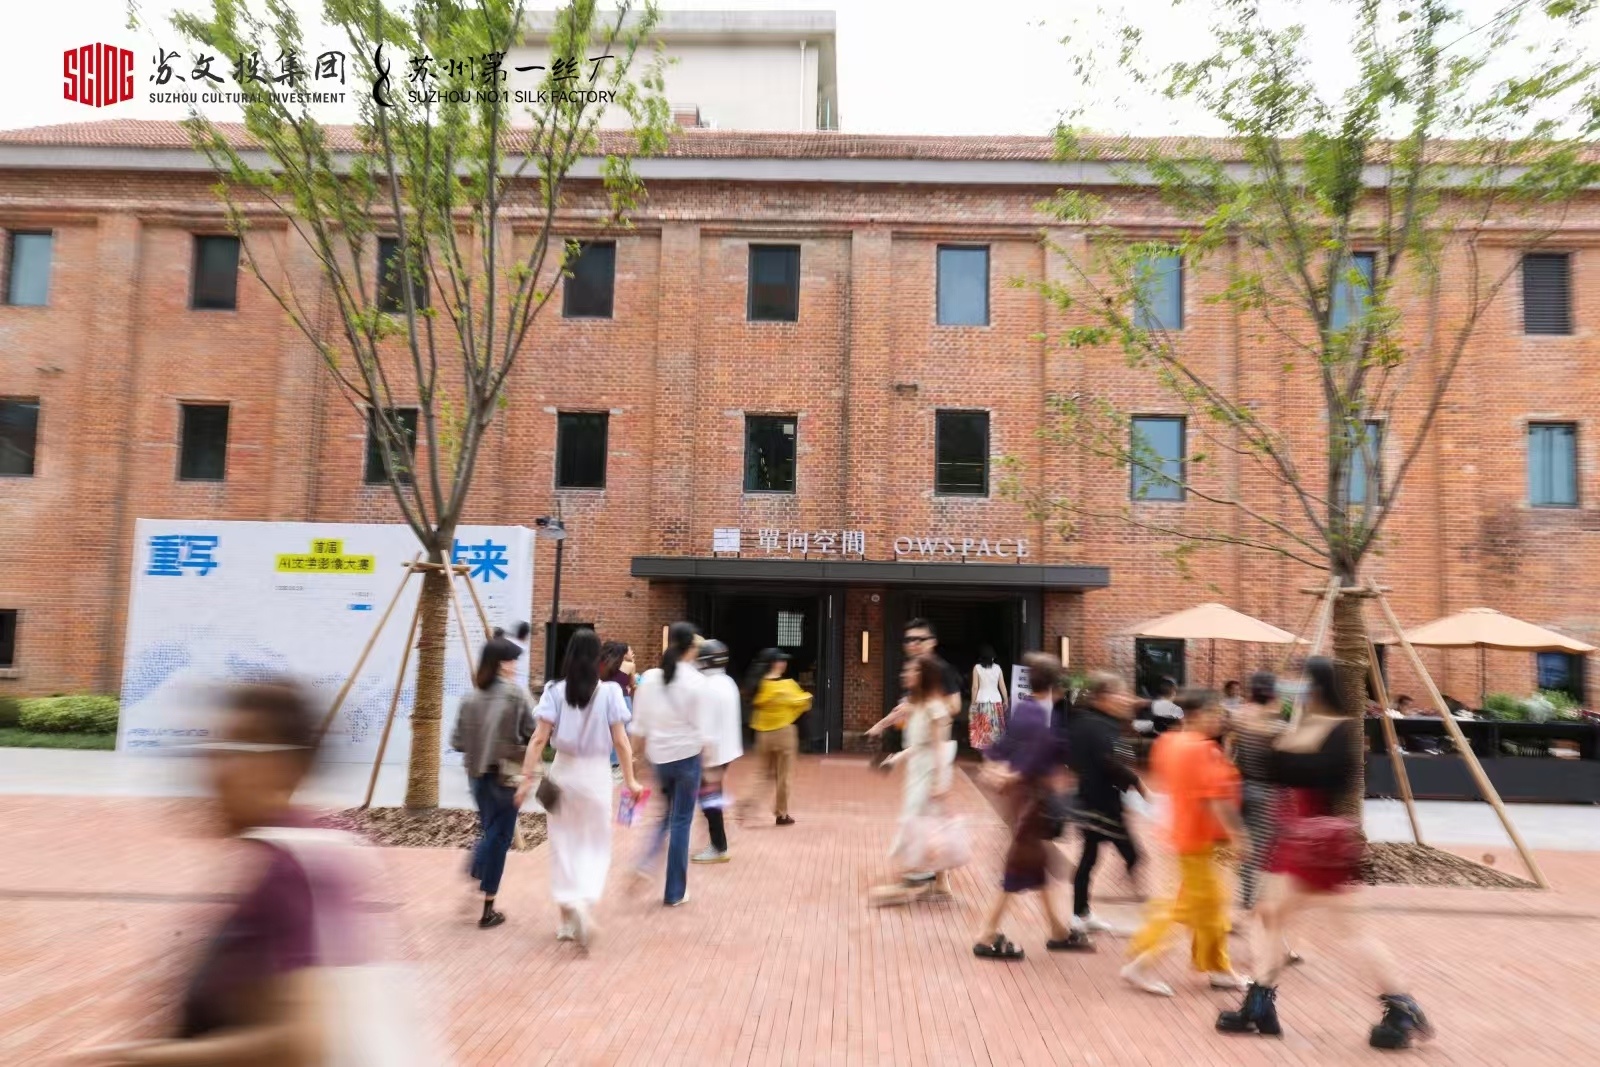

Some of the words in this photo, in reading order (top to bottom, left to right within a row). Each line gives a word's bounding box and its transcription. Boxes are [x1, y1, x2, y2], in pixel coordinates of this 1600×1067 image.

[146, 534, 219, 577] 重写
[757, 528, 866, 556] 單向空間
[894, 536, 1030, 558] OWSPACE
